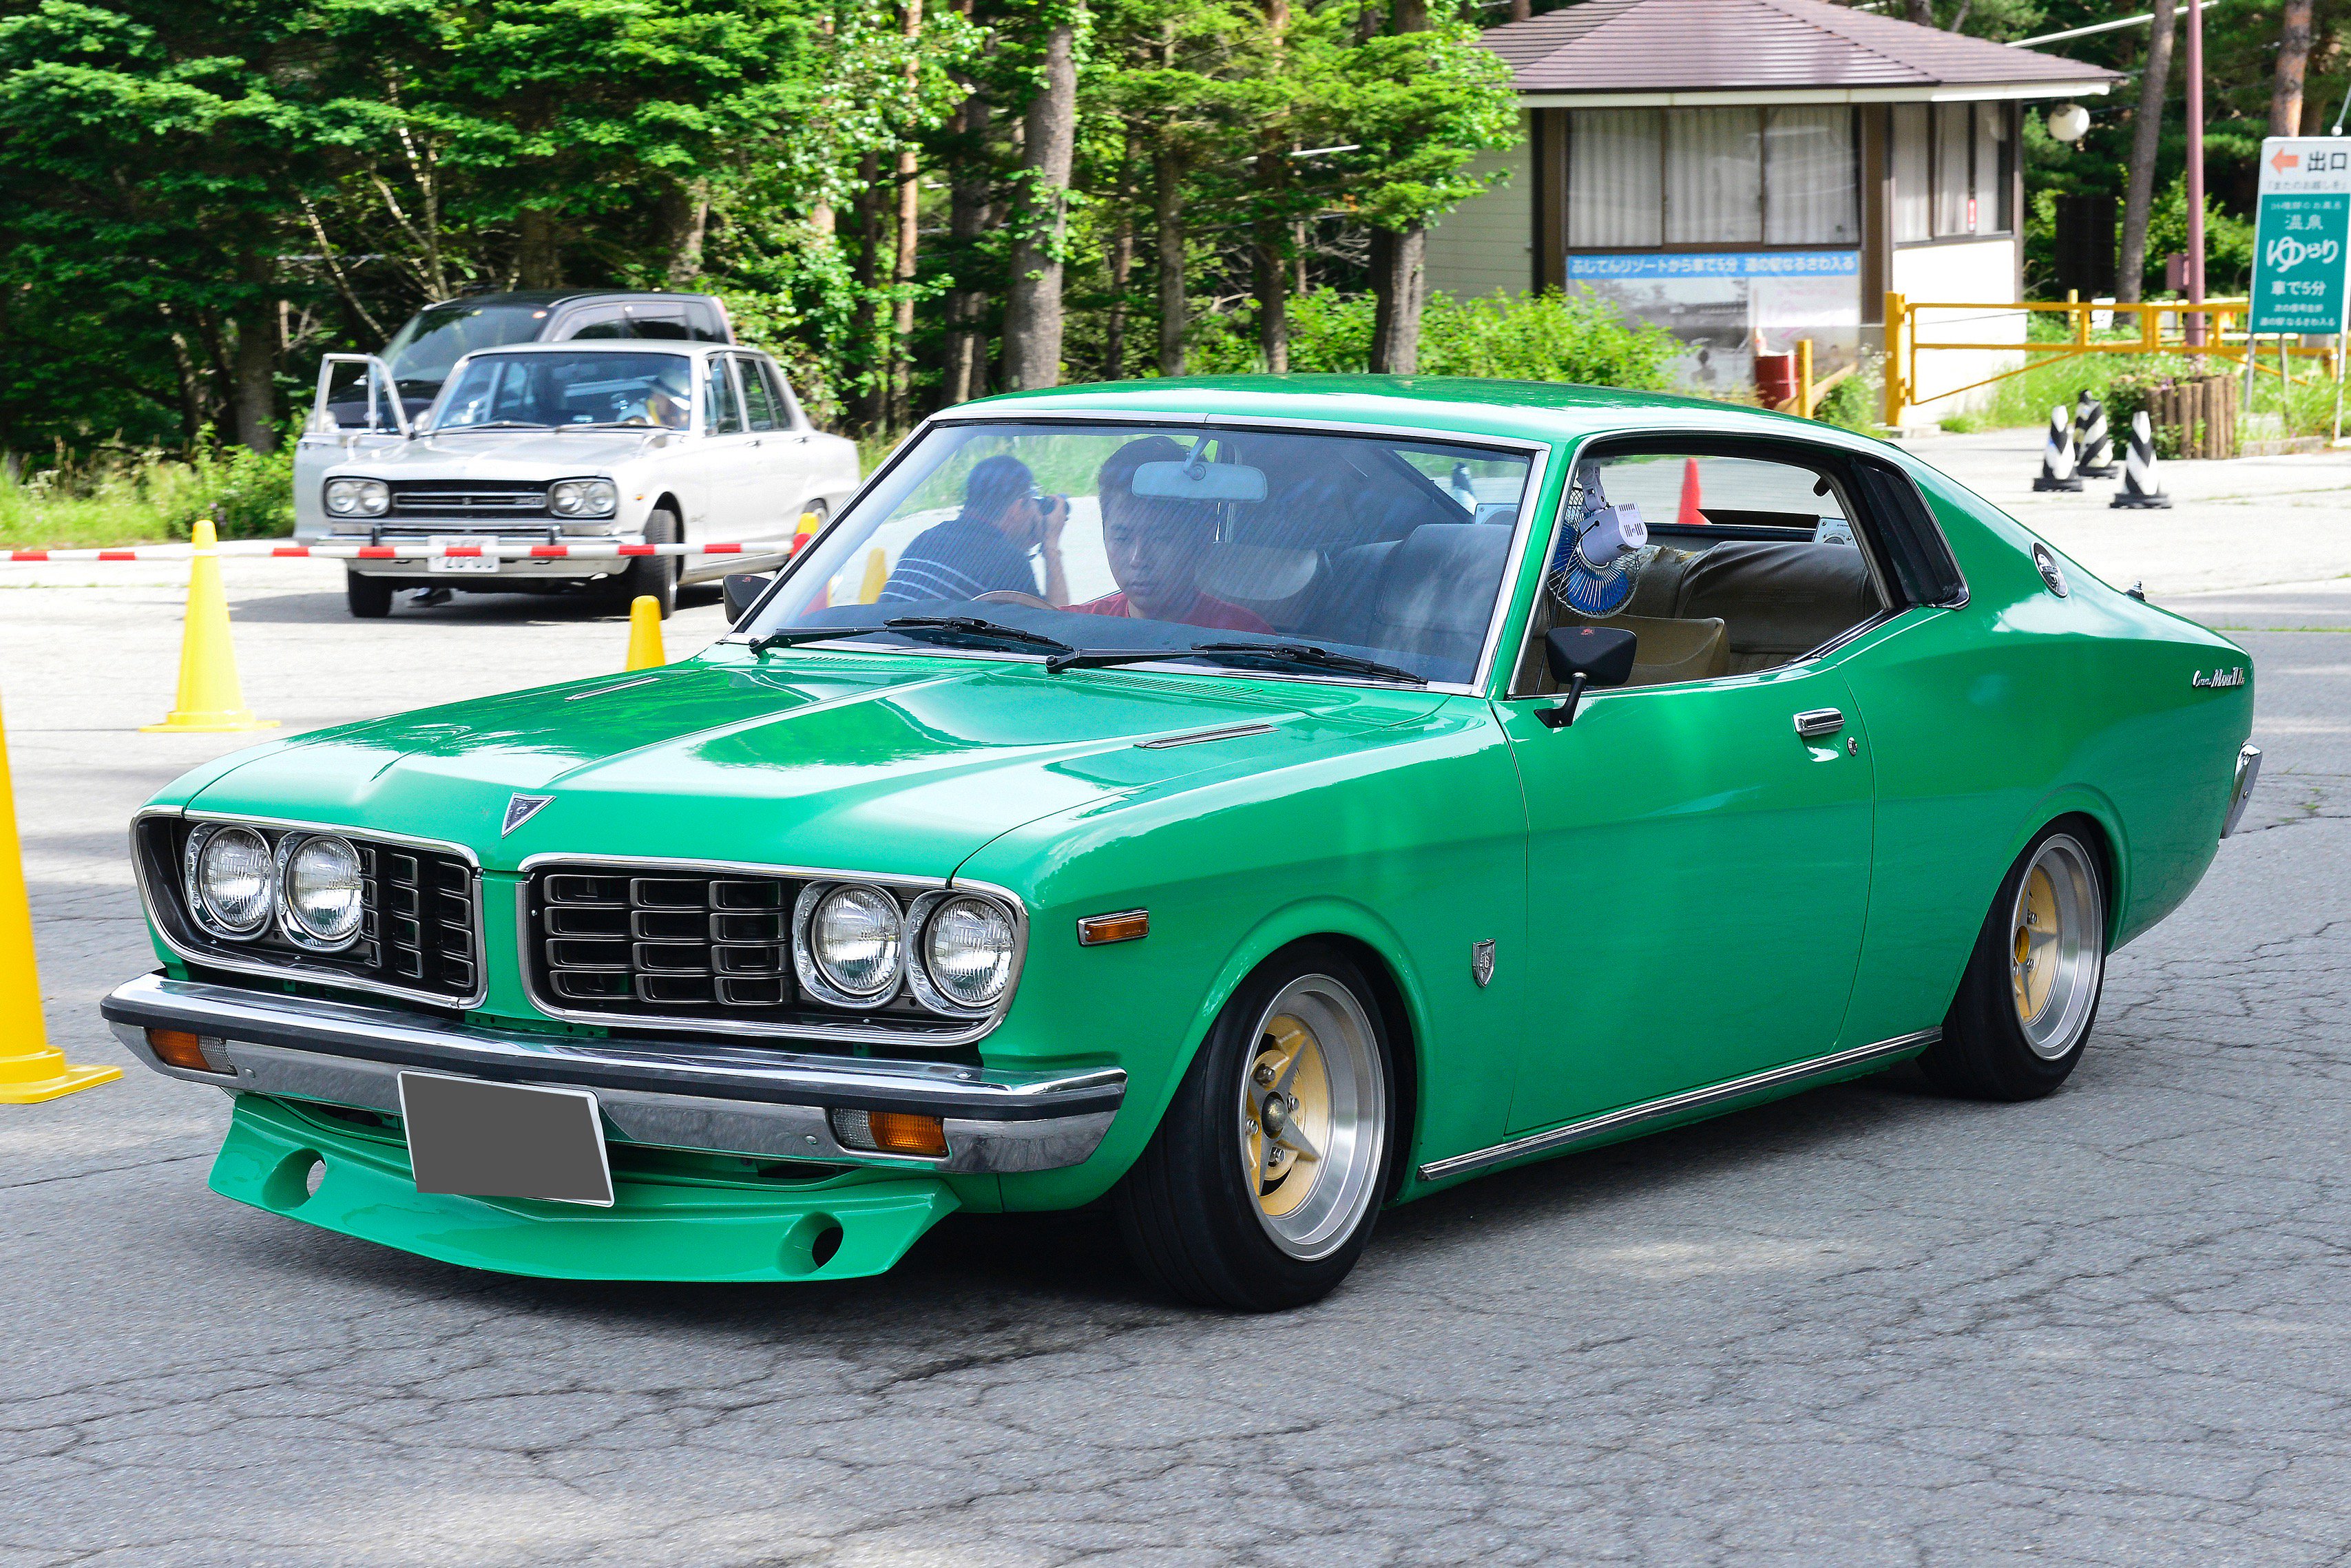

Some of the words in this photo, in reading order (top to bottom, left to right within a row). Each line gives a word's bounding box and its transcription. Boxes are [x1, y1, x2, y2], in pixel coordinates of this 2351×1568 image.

[2308, 151, 2347, 172] 出口
[2285, 214, 2323, 230] 温泉
[2266, 236, 2339, 273] ゆらり
[2270, 280, 2327, 296] 車で5分
[1484, 956, 1490, 968] 6
